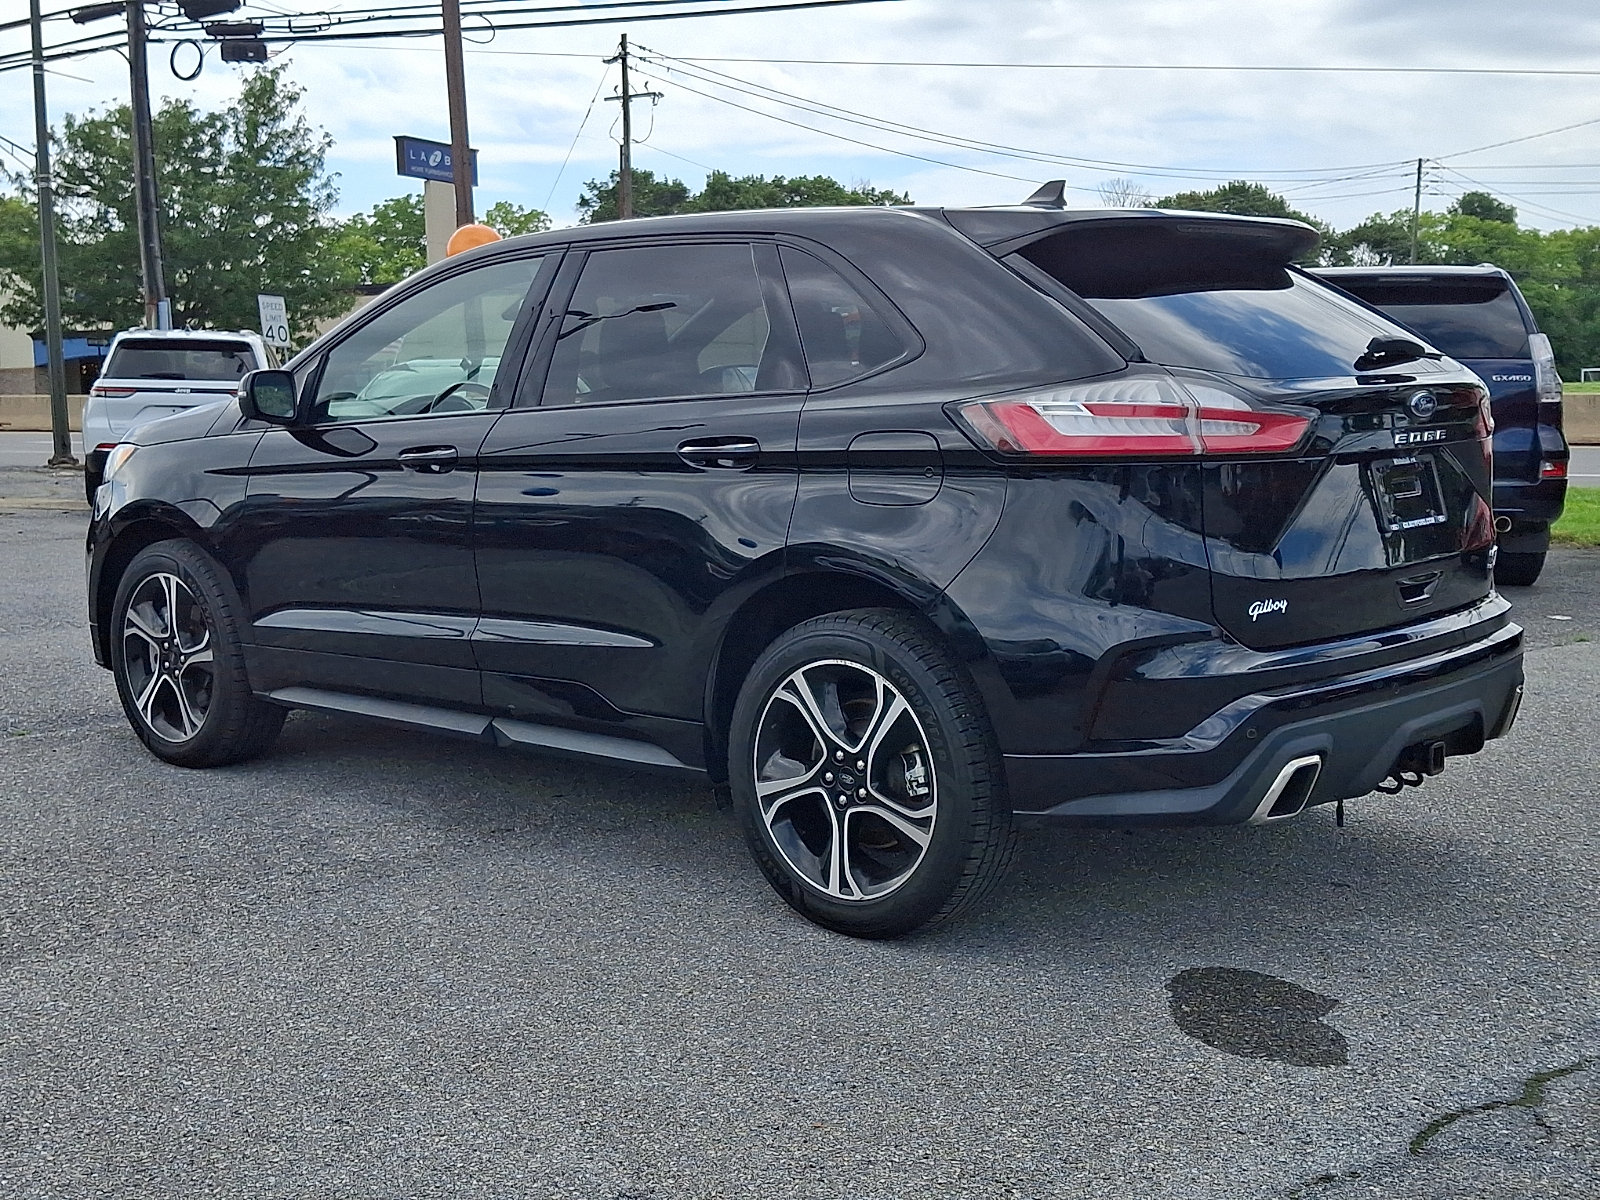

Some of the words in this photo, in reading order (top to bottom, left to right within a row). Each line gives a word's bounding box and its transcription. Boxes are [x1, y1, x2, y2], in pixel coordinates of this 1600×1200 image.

[262, 302, 283, 310] SPEED
[265, 325, 288, 342] 40
[1394, 429, 1447, 444] EDGE
[1248, 598, 1288, 622] Gilboy
